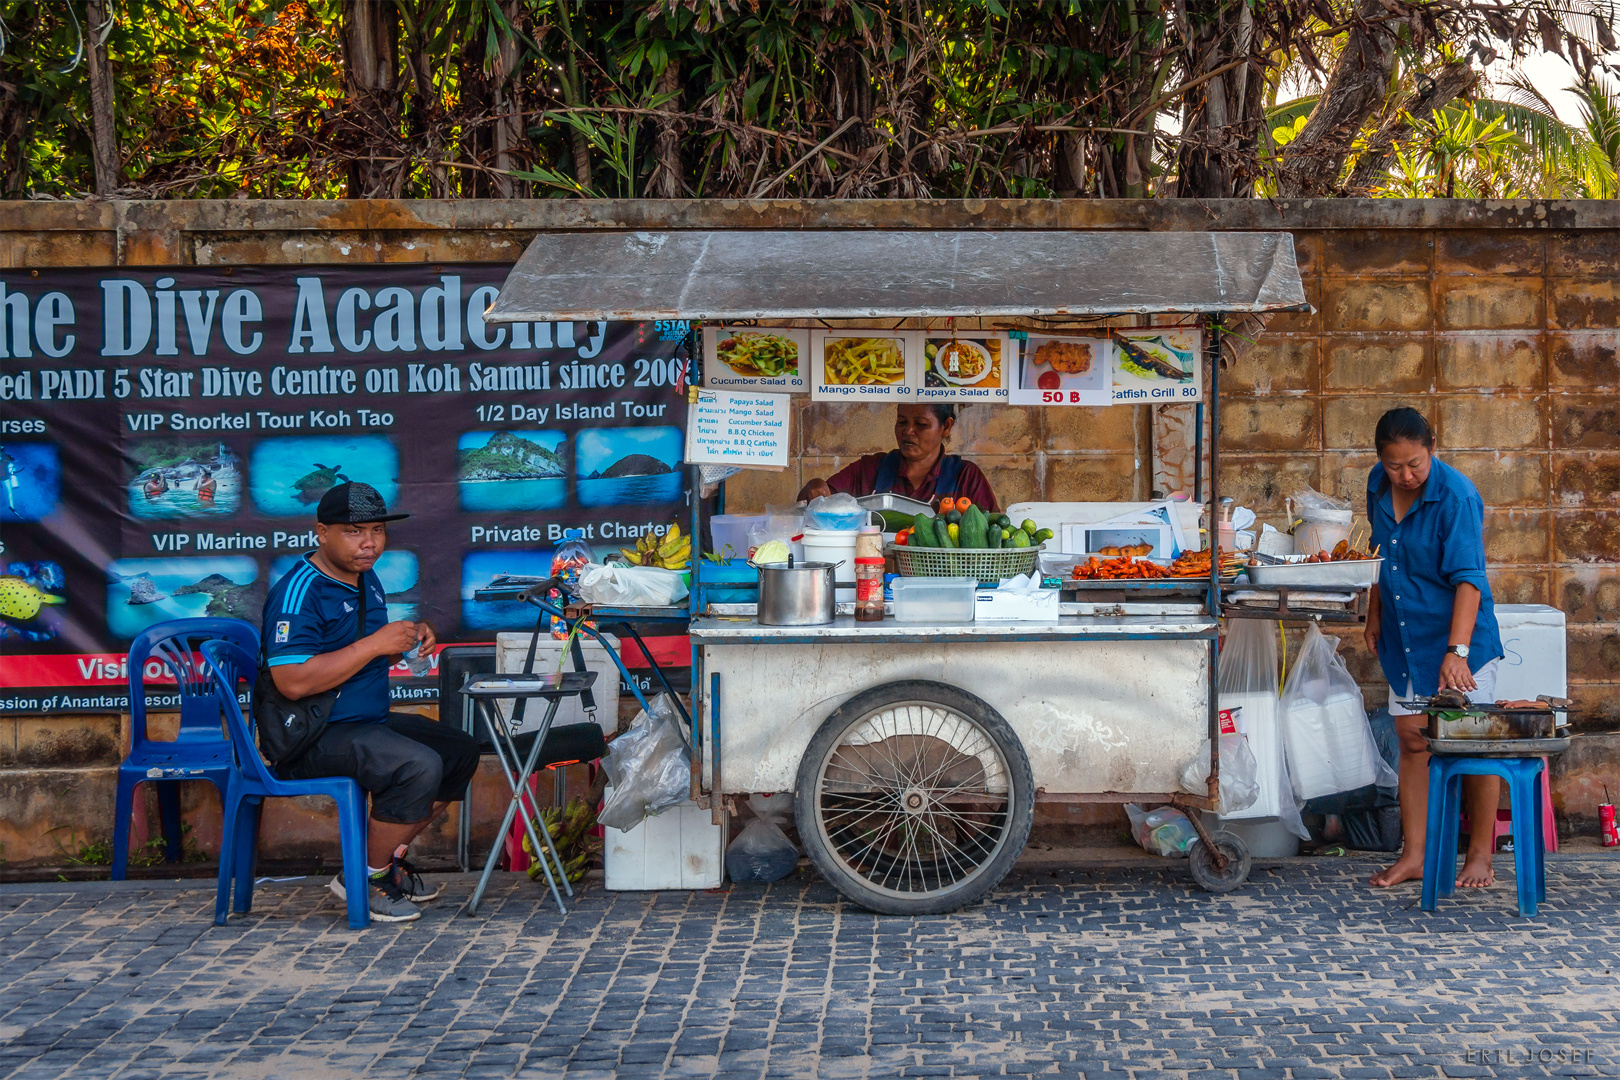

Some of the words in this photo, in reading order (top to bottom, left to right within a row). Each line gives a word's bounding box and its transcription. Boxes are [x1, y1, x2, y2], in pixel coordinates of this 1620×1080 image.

[100, 277, 263, 356] Dive
[40, 369, 106, 400] PADI
[114, 369, 131, 398] 5
[140, 367, 194, 398] Star
[202, 366, 263, 396] Dive
[271, 365, 357, 395] Centre
[365, 367, 400, 394] on
[408, 363, 461, 393] Koh
[469, 361, 551, 392] Samui
[559, 360, 626, 390] since
[710, 377, 757, 385] Cucumber
[760, 378, 786, 386] Salad
[791, 378, 803, 386] 60
[818, 385, 856, 395] Mango
[859, 385, 890, 394] Salad
[896, 386, 911, 395] 60
[916, 388, 956, 397] Papaya
[959, 388, 989, 396] Salad
[995, 388, 1009, 397] 60
[1151, 388, 1175, 397] Grill
[1182, 387, 1197, 397] 80
[729, 398, 753, 406] Papaya
[1042, 391, 1064, 403] 50
[476, 405, 506, 423] 1/2
[510, 404, 550, 424] Day
[555, 403, 615, 421] Island
[621, 401, 667, 419] Tour
[728, 408, 752, 416] Mango
[127, 413, 165, 431] VIP
[170, 411, 251, 430] Snorkel
[257, 411, 304, 429] Tour
[309, 410, 351, 427] Koh
[357, 409, 394, 427] Tao
[728, 418, 762, 426] Cucumber
[727, 428, 746, 437] B.B.Q
[748, 429, 774, 437] Chicken
[733, 439, 752, 447] B.B.Q
[754, 439, 777, 447] Catfish
[471, 523, 541, 542] Private
[153, 534, 190, 551] VIP
[196, 532, 267, 550] Marine
[273, 531, 320, 548] Park
[78, 658, 128, 680] Visi
[389, 685, 440, 699] นันตรา
[42, 695, 58, 708] of
[60, 695, 129, 708] Anantara
[144, 693, 183, 706] esort
